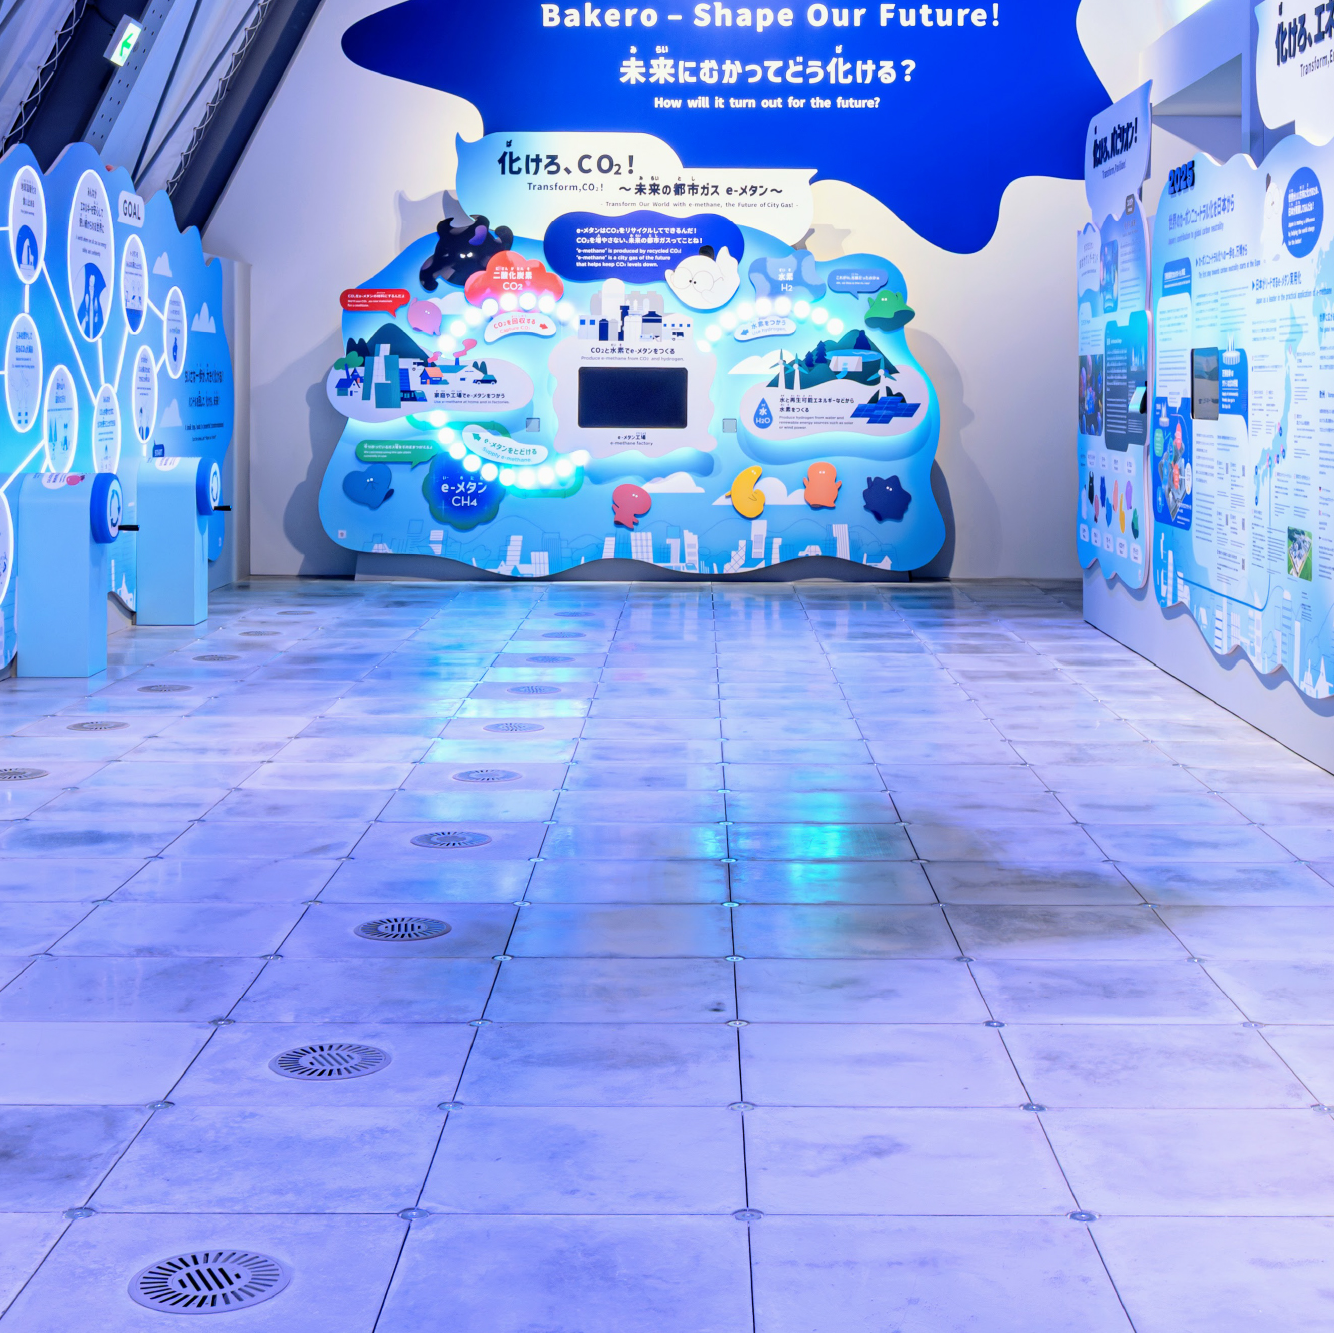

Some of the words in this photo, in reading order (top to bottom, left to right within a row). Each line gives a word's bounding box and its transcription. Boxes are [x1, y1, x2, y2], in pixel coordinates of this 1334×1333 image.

[541, 2, 658, 27] Bakero
[693, 2, 794, 32] Shape
[807, 3, 866, 27] Our
[880, 2, 999, 27] Future!
[619, 57, 916, 84] 未来にむかってどう化ける？
[654, 97, 682, 108] How
[687, 97, 709, 108] will
[730, 98, 756, 108] turn
[761, 98, 782, 108] out
[787, 97, 805, 108] for
[810, 97, 831, 108] the
[836, 97, 880, 108] future?
[1168, 160, 1195, 195] 2025
[123, 199, 142, 220] GOAL
[493, 271, 532, 280] 二酸化炭素
[751, 319, 786, 330] 水素をつかう
[441, 482, 487, 494] e-メタン
